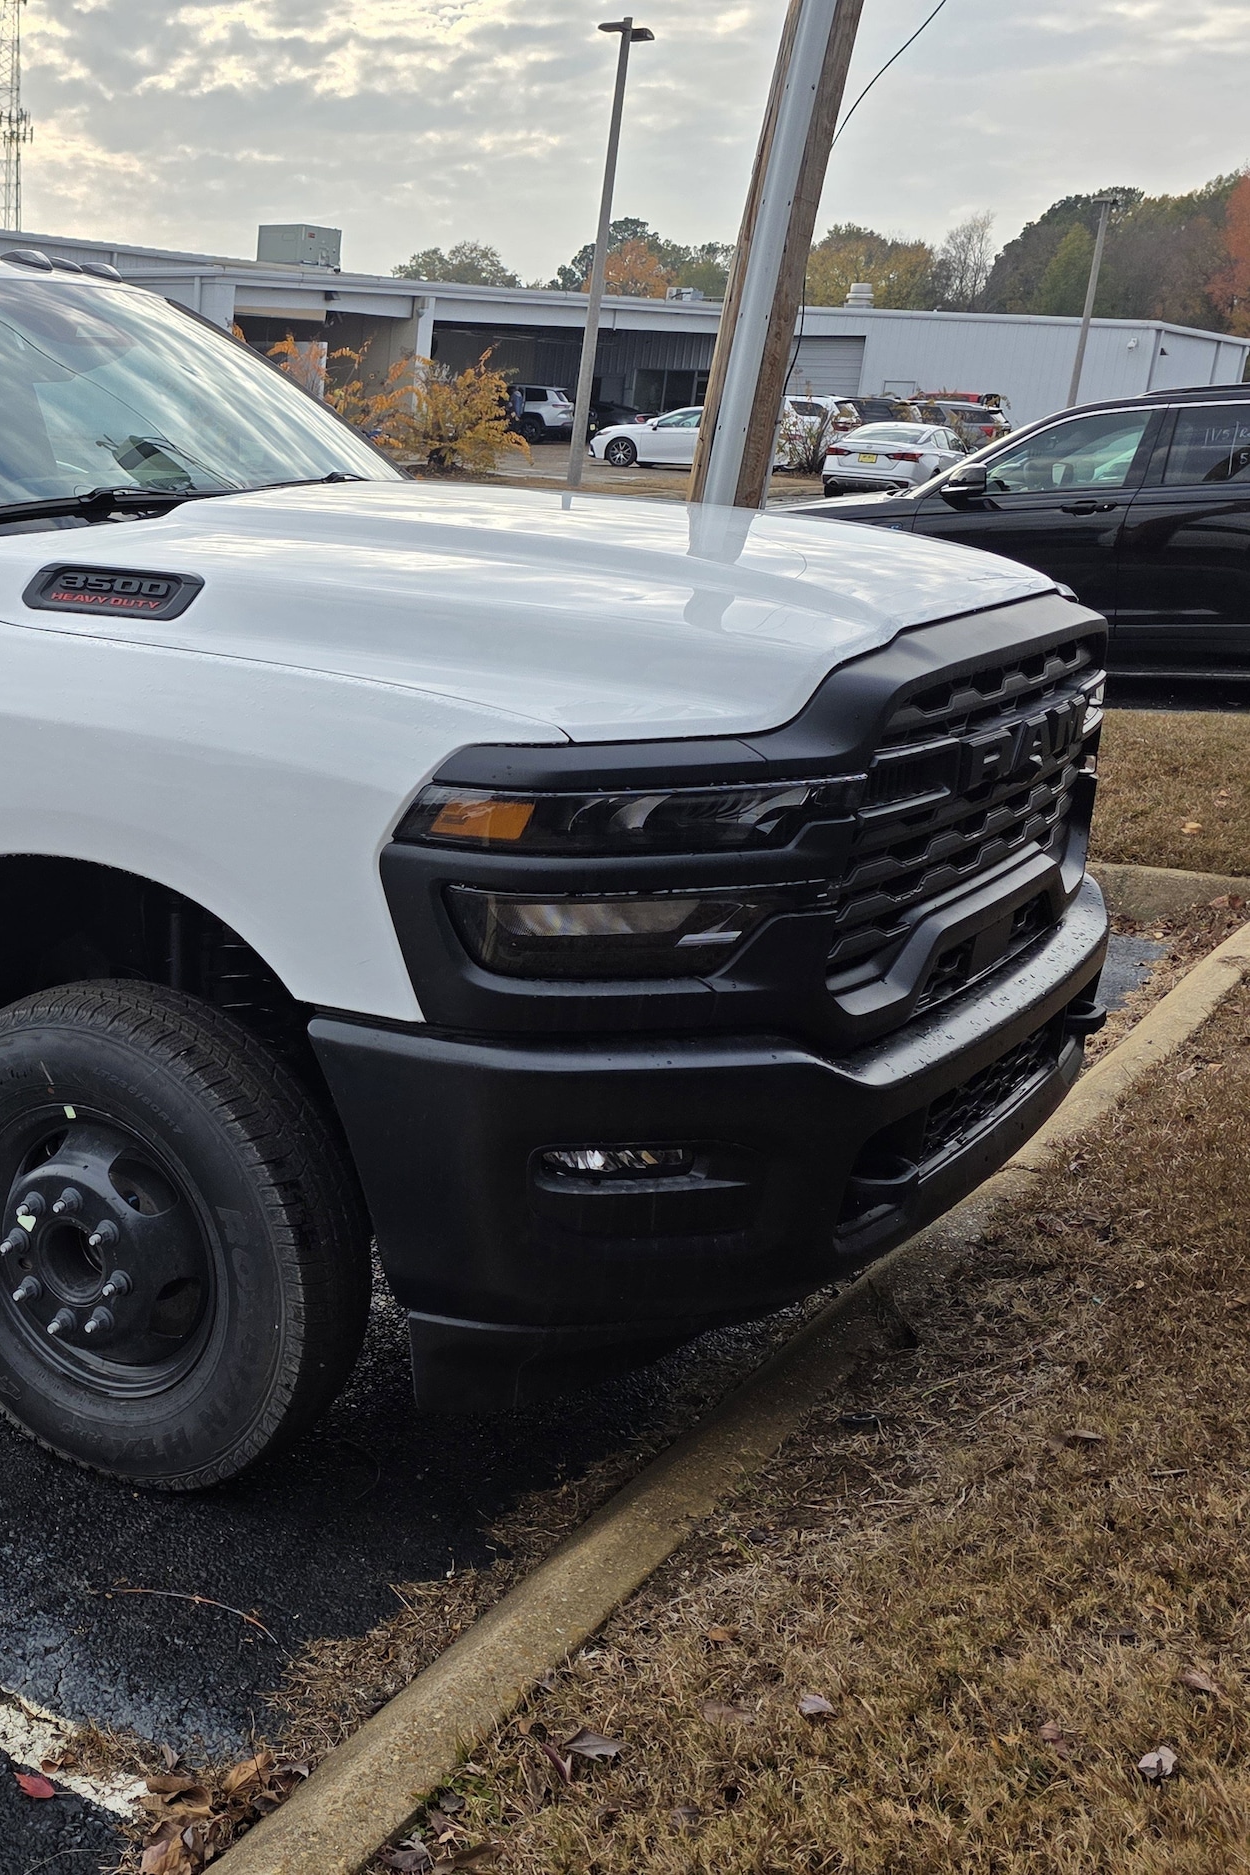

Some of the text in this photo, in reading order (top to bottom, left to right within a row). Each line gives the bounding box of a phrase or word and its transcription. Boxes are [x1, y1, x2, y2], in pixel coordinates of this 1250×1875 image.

[60, 574, 171, 598] 3500
[51, 592, 161, 609] HEAVY DUTY
[958, 694, 1088, 794] RAM
